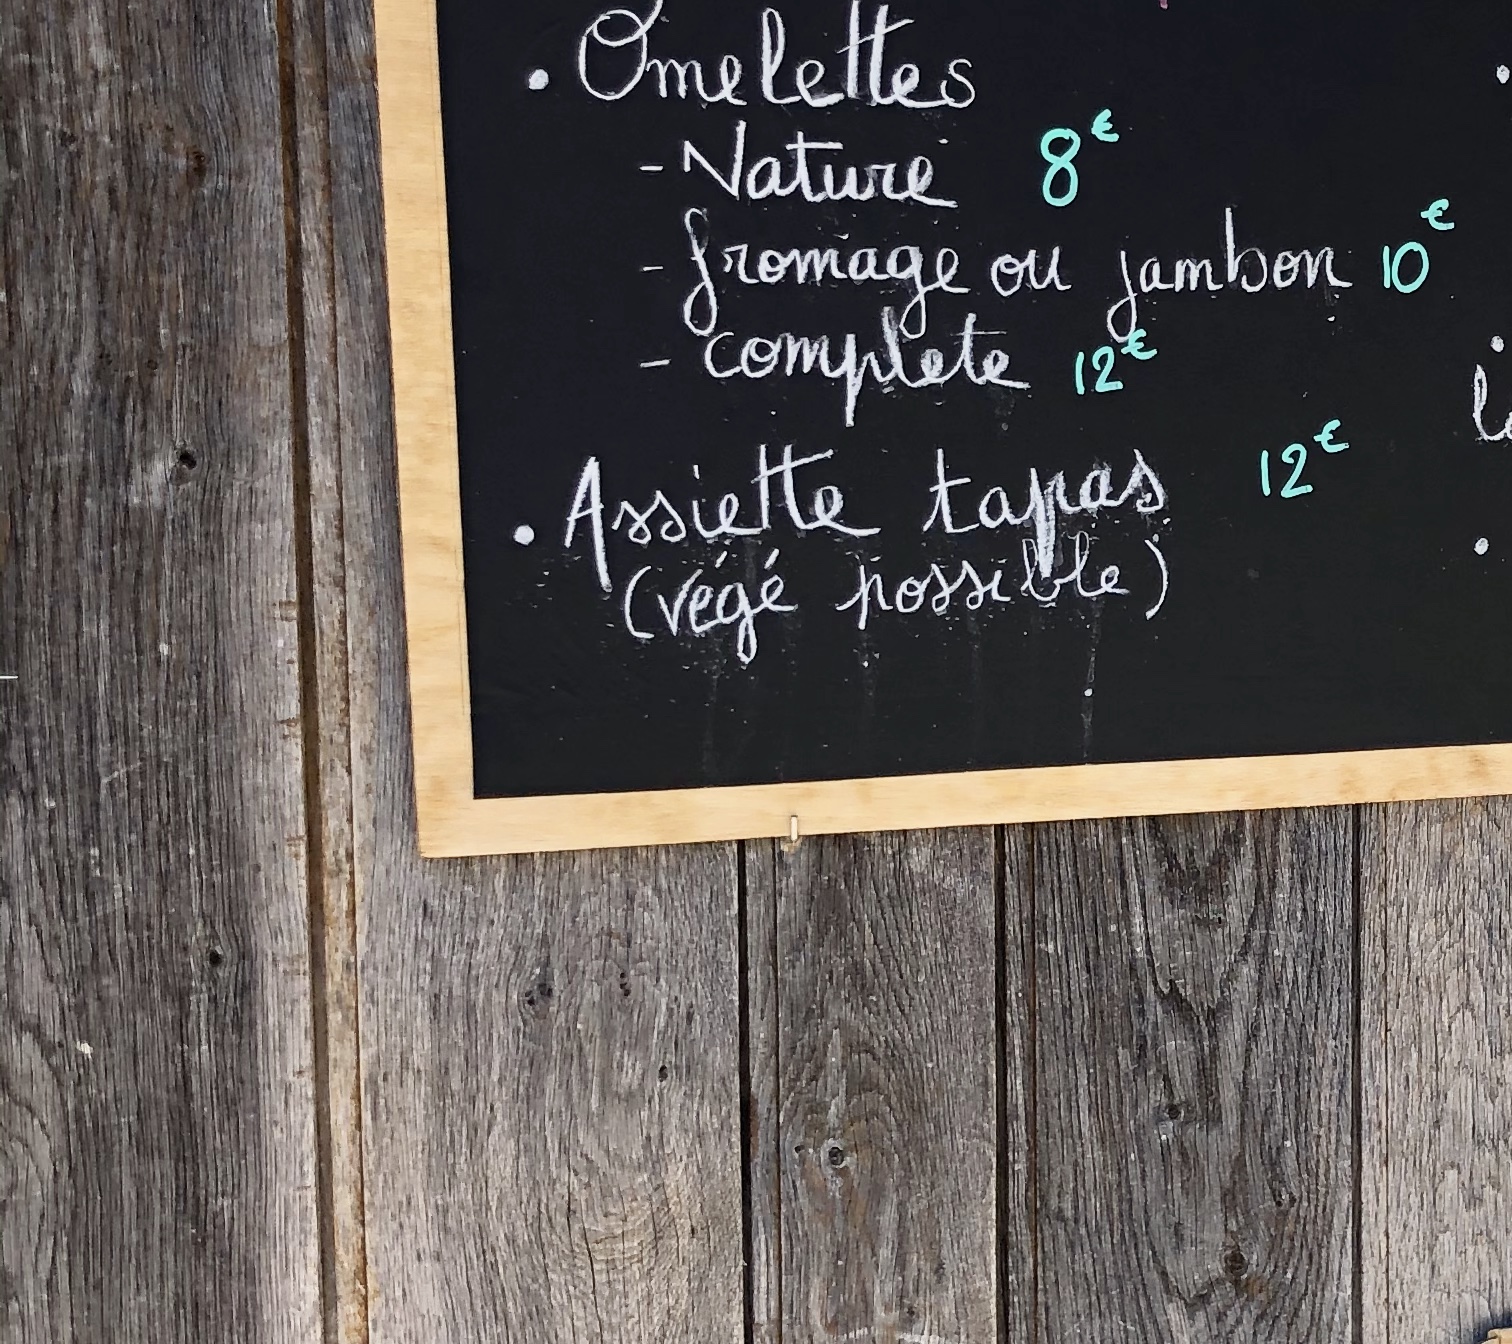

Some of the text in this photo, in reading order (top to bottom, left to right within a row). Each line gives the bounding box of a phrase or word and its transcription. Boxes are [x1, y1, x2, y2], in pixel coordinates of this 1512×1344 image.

[991, 247, 1072, 296] ou
[1107, 207, 1353, 340] jambon
[564, 444, 881, 592] Assiette
[923, 448, 1167, 578] tapas
[624, 530, 1170, 664] (végé possible)
